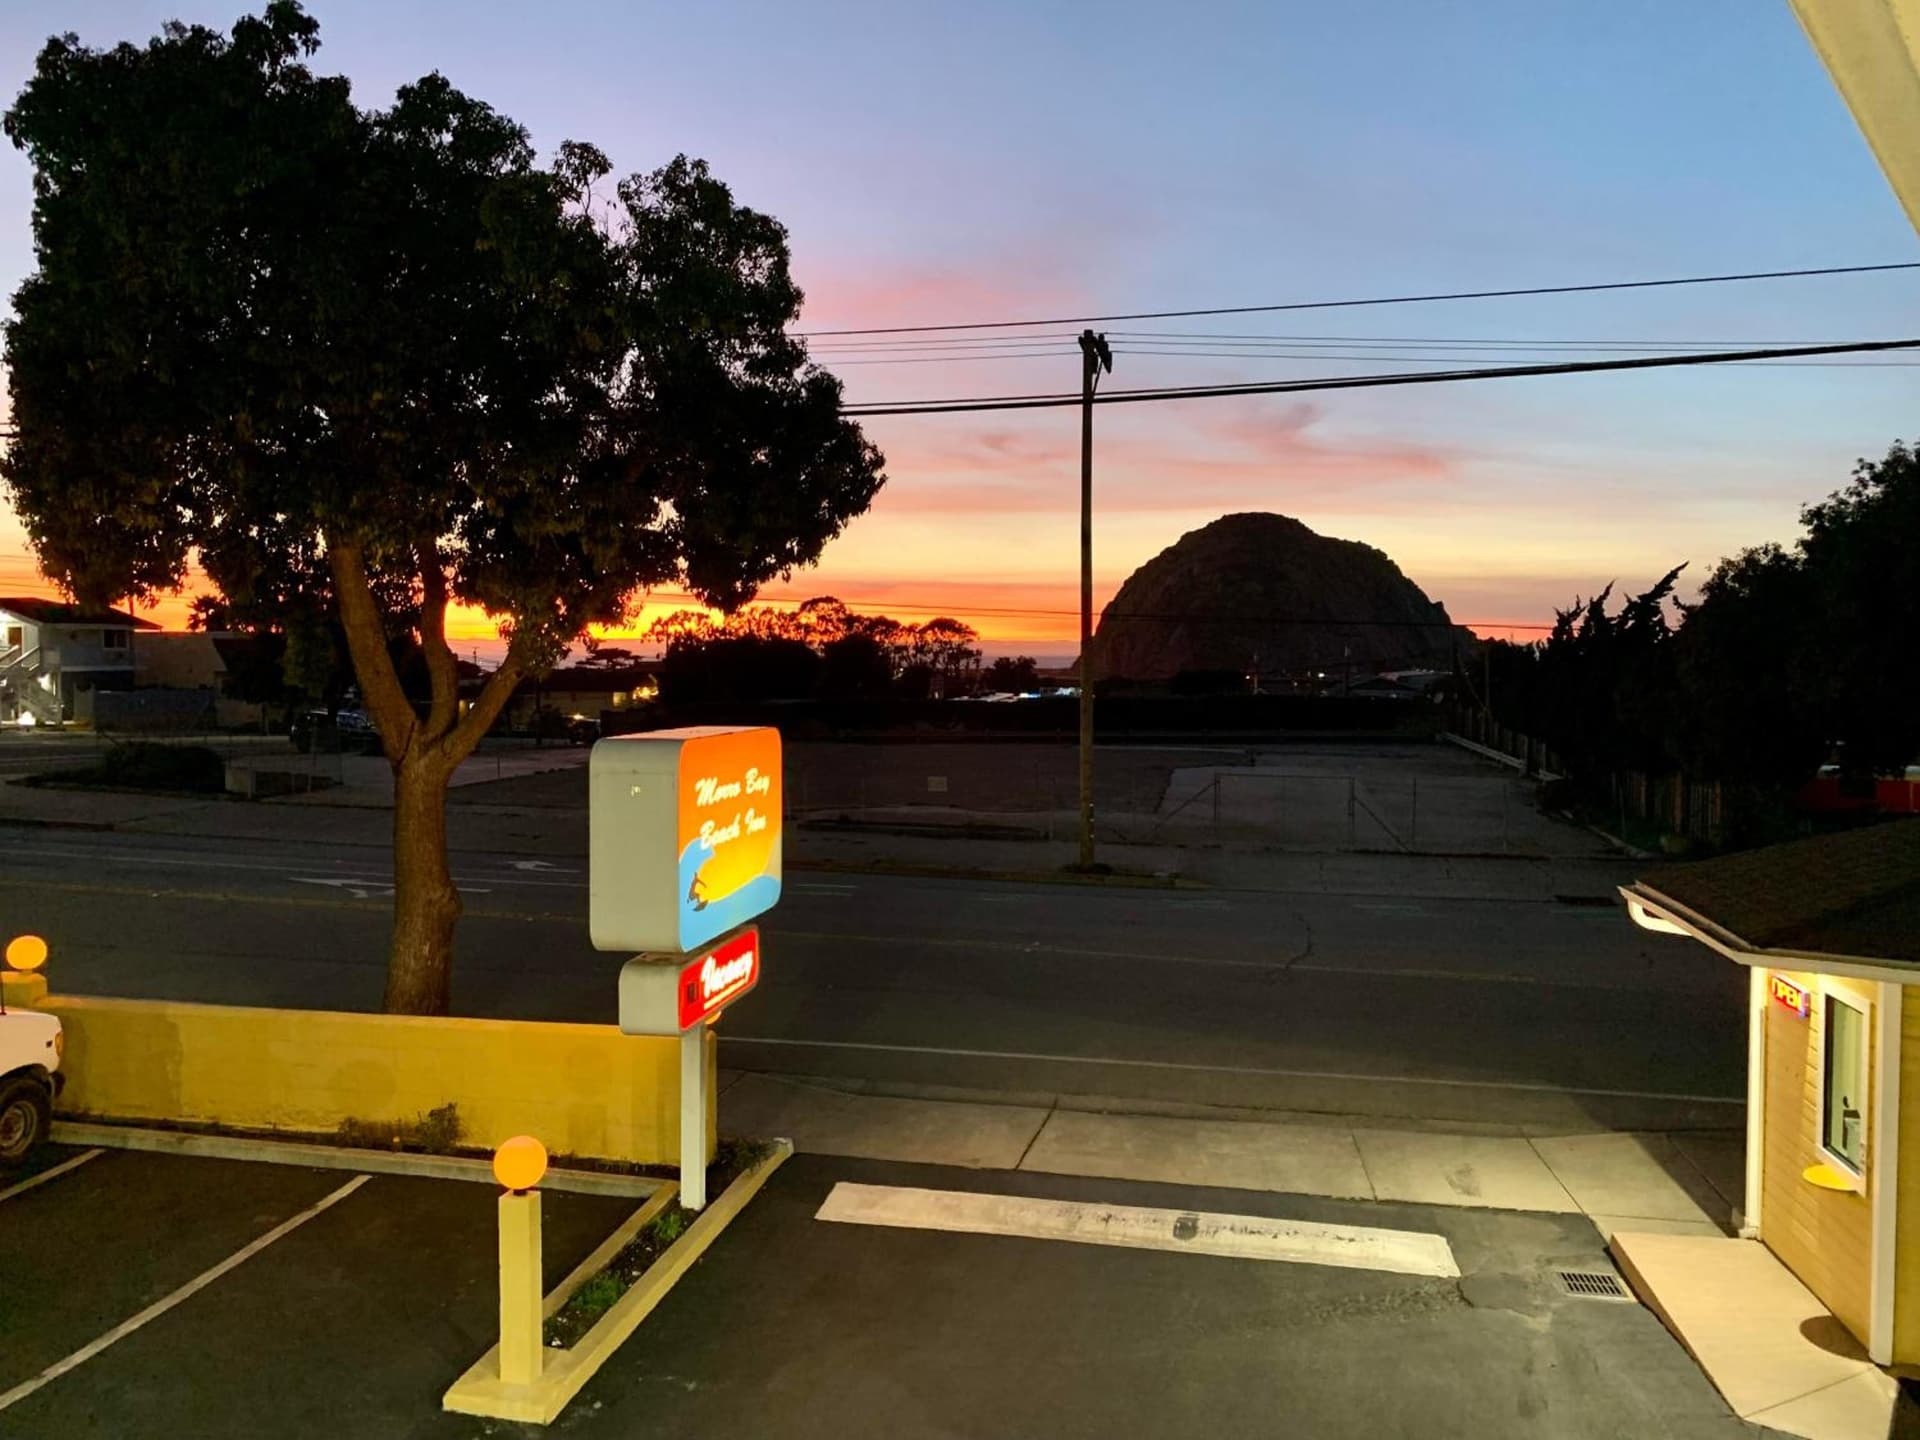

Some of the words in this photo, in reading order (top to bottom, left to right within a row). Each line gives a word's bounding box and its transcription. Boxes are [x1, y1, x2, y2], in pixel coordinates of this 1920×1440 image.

[745, 767, 770, 796] Bay
[700, 813, 741, 850] Beach
[744, 807, 767, 836] Inn
